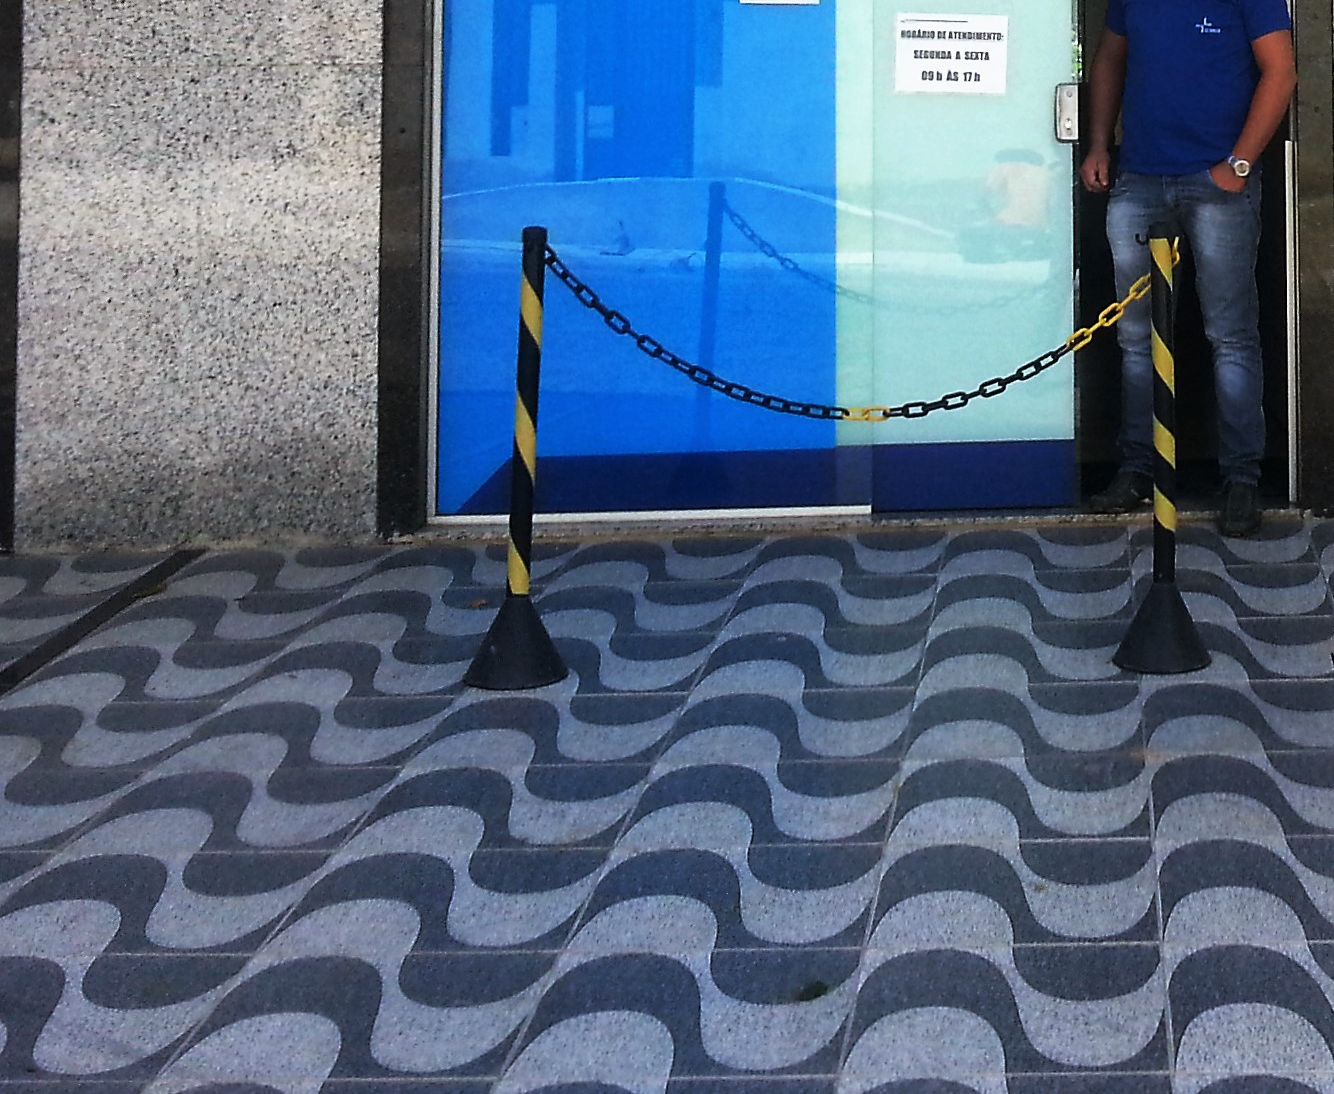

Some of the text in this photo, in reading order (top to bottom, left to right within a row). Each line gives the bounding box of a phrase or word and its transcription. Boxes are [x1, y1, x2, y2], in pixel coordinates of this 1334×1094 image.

[900, 28, 936, 40] HORÁRIO
[936, 30, 947, 40] DE
[913, 49, 990, 61] SEGUNDA A SEXTA
